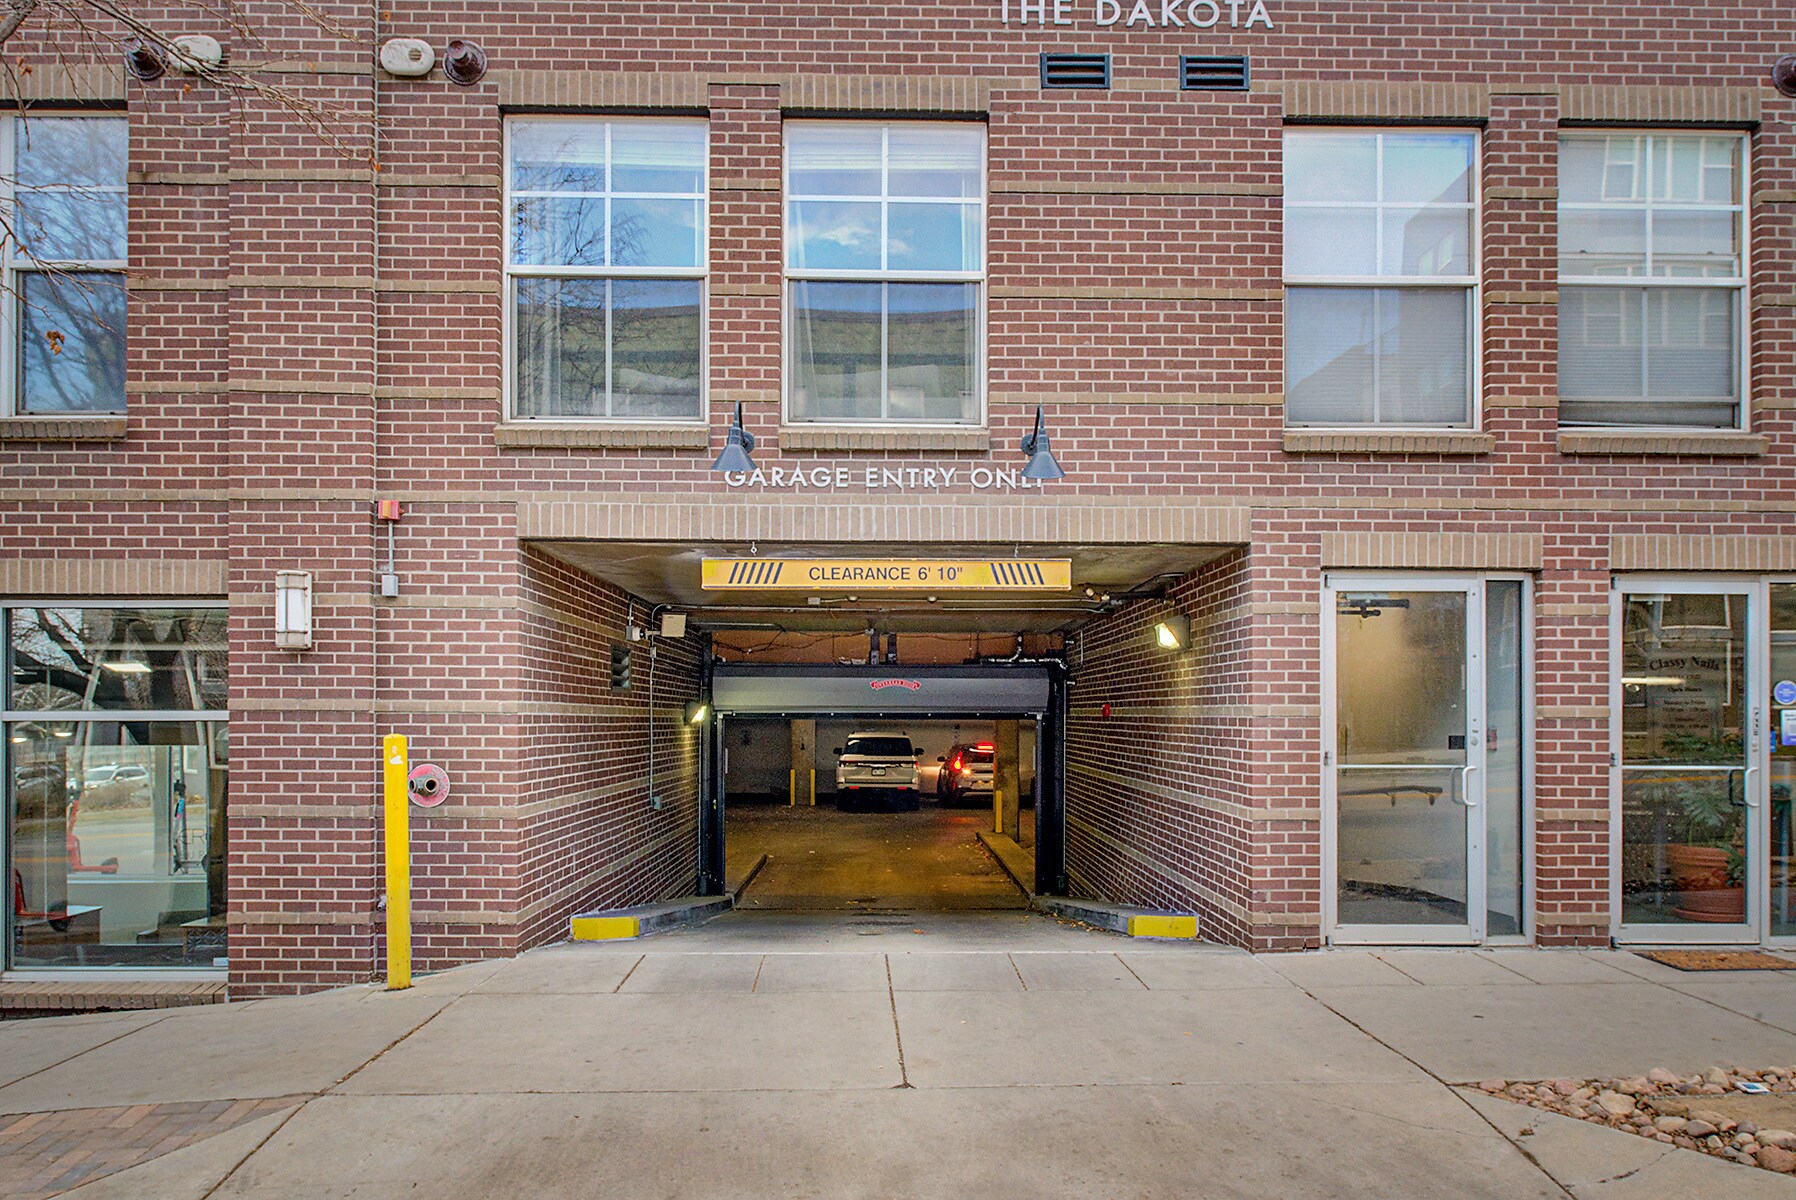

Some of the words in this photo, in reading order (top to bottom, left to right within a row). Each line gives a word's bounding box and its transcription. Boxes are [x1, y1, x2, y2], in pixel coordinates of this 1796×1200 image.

[1097, 0, 1274, 28] DAKOTA
[724, 466, 849, 488] GARAGE
[866, 467, 956, 489] ENTRY
[809, 566, 911, 581] CLEARANCE
[918, 566, 931, 581] 6'
[938, 566, 963, 581] 10"
[1650, 658, 1685, 671] Classy
[1691, 656, 1719, 671] Nails
